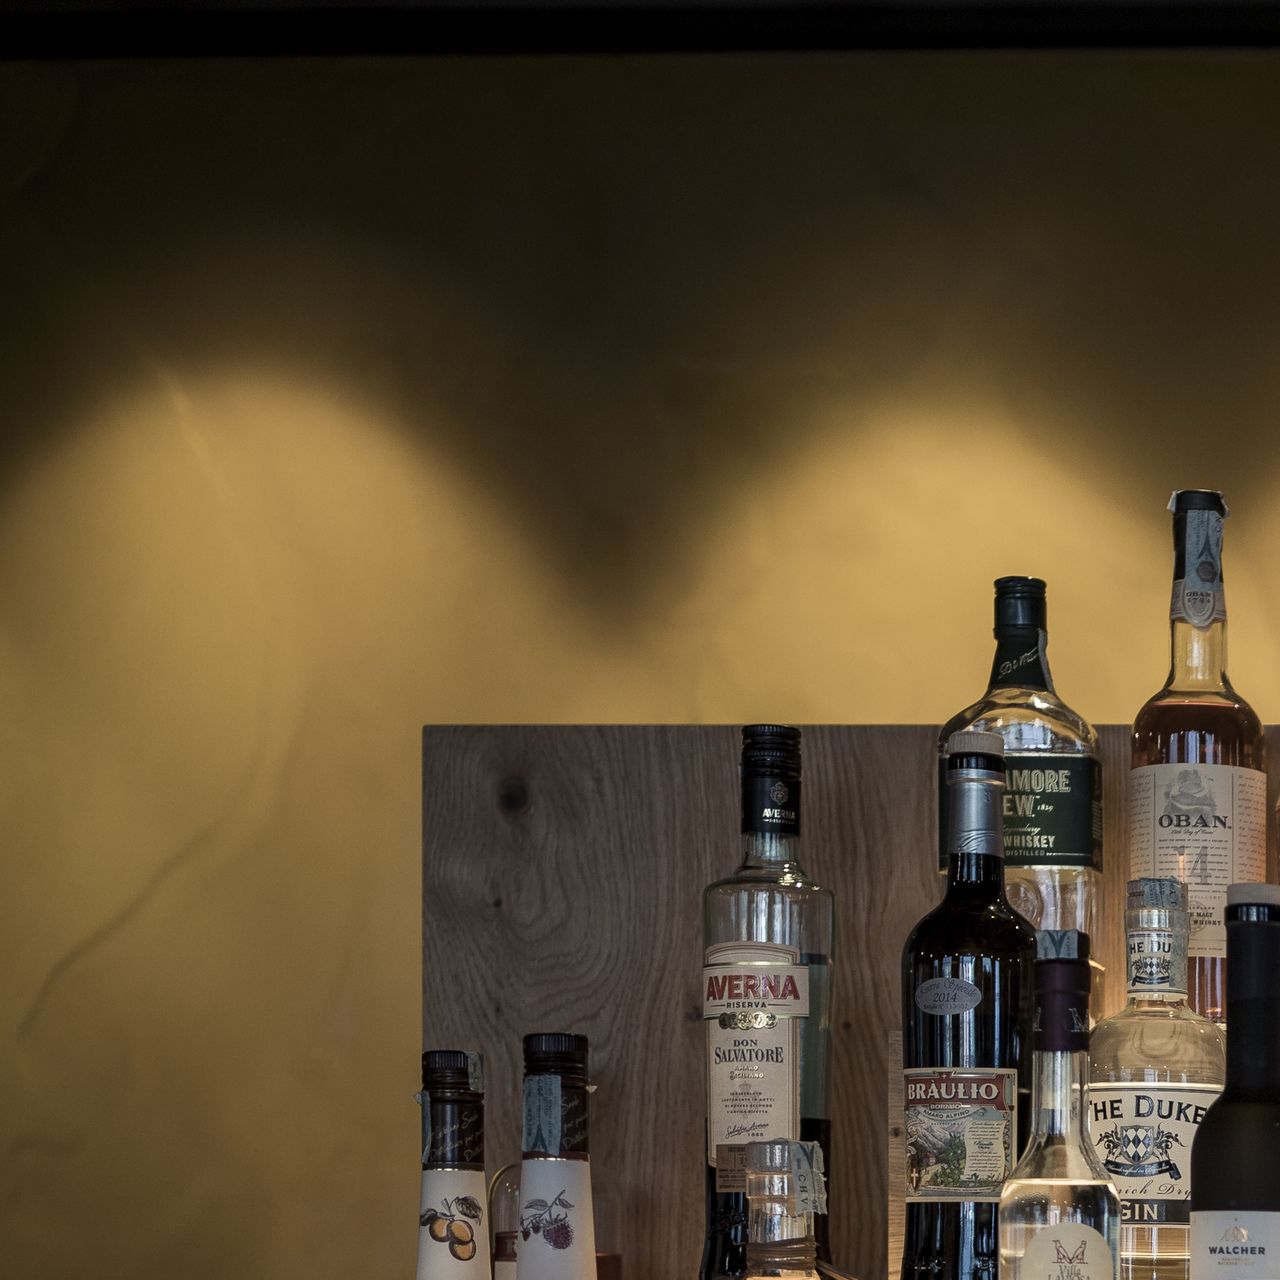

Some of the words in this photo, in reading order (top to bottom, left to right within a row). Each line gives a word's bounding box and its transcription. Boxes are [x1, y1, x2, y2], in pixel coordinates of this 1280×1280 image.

[762, 807, 797, 820] AVERNA
[1158, 813, 1229, 829] OBAN
[1004, 835, 1056, 849] WHISKEY
[706, 974, 801, 1002] AVERNA
[932, 991, 959, 1003] 2014
[726, 1001, 768, 1009] RISERVA
[733, 1039, 758, 1048] DON
[714, 1046, 784, 1065] SALVATORE
[923, 1109, 945, 1119] AMARO
[945, 1109, 971, 1120] ALPINO
[1089, 1098, 1124, 1122] HE
[1134, 1094, 1209, 1126] DUKE
[1156, 1182, 1192, 1203] Dry
[1120, 1200, 1158, 1221] GIN
[1208, 1246, 1266, 1256] WALCHER
[1058, 1264, 1081, 1276] Villa
